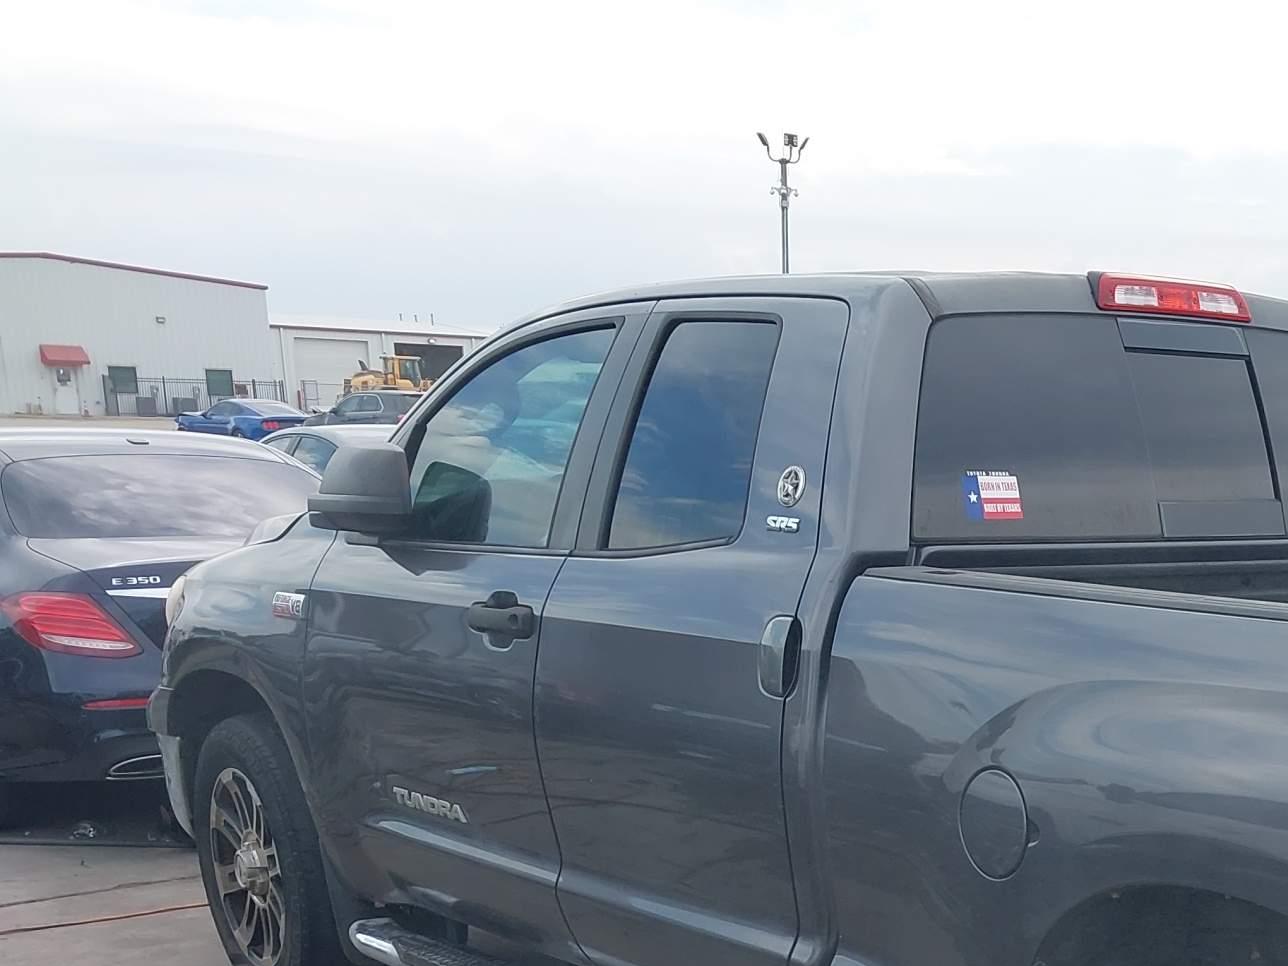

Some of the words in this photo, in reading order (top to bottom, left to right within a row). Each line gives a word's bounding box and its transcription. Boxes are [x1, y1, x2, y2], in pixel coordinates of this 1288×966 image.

[766, 515, 800, 532] SR5
[111, 577, 123, 586] E
[126, 575, 161, 585] 350
[392, 786, 468, 824] TUNDRA
